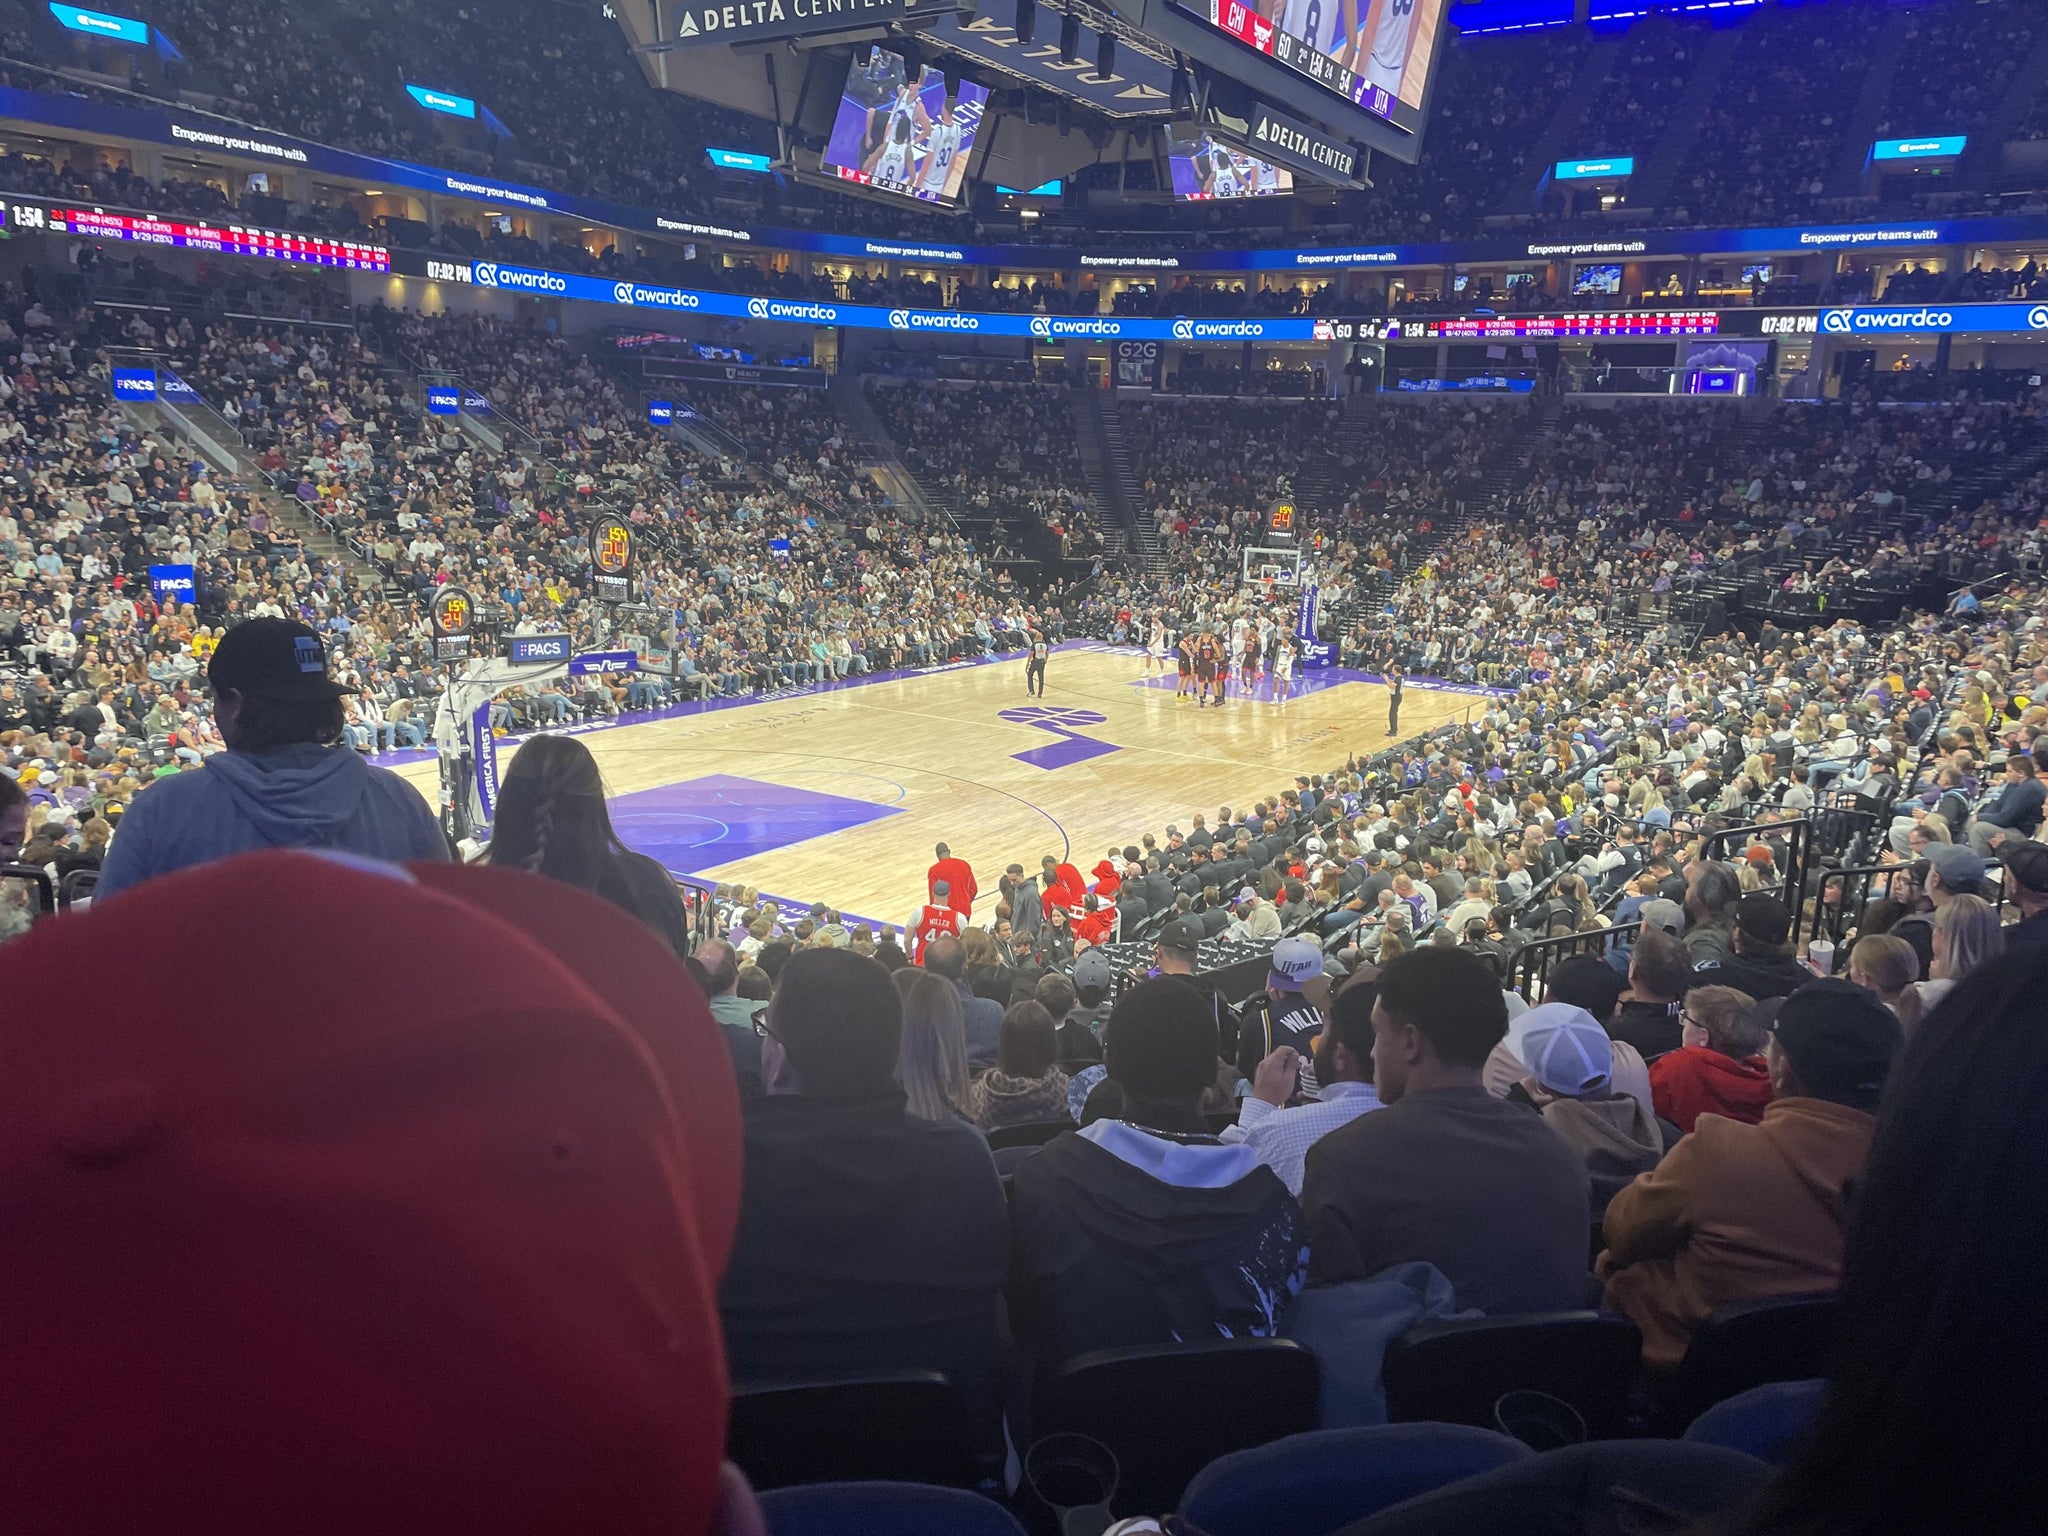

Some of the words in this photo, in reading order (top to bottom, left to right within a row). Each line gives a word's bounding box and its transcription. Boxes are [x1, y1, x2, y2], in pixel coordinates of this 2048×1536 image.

[704, 0, 785, 32] DELTA
[1228, 2, 1246, 33] CHI
[1277, 33, 1291, 60] 60
[1309, 51, 1324, 78] 1:54
[1324, 62, 1334, 80] 24
[1339, 68, 1351, 94] 54
[1374, 88, 1390, 113] UTA
[172, 125, 225, 145] Empower
[225, 136, 250, 149] your
[250, 140, 283, 156] teams
[284, 148, 307, 162] with
[1270, 122, 1309, 156] DELTA
[1312, 142, 1352, 174] CENTER
[936, 147, 952, 167] 30
[447, 177, 486, 194] Empower
[486, 188, 505, 198] your
[505, 190, 529, 203] teams
[530, 196, 547, 207] with
[12, 205, 44, 228] 1:54
[657, 217, 692, 233] Empower
[693, 223, 710, 235] your
[710, 225, 733, 237] teams
[733, 229, 750, 240] with
[1801, 232, 1851, 244] Empower
[1852, 231, 1876, 242] your
[1877, 230, 1911, 240] teams
[1912, 229, 1938, 240] with
[233, 244, 240, 252] 3
[266, 248, 276, 257] 22
[283, 250, 291, 259] 13
[300, 252, 306, 261] 4
[316, 254, 321, 263] 3
[332, 257, 337, 265] 3
[346, 259, 355, 267] 20
[361, 261, 371, 269] 104
[866, 243, 902, 255] Empower
[902, 247, 919, 257] your
[920, 247, 944, 258] teams
[945, 251, 962, 260] with
[1528, 244, 1571, 255] Empower
[1571, 243, 1592, 254] your
[1593, 242, 1622, 252] teams
[1623, 242, 1645, 251] with
[1081, 256, 1117, 267] Empower
[1118, 257, 1136, 267] your
[1136, 257, 1160, 266] teams
[1161, 257, 1178, 267] with
[1297, 254, 1333, 265] Empower
[1333, 254, 1352, 263] your
[1353, 252, 1378, 262] teams
[1378, 252, 1396, 261] with
[427, 261, 455, 280] 07:02
[456, 265, 472, 282] PM
[500, 271, 566, 291] awardco
[636, 288, 699, 308] awardco
[770, 303, 836, 320] awardco
[1856, 308, 1952, 328] awardco
[911, 313, 979, 329] awardco
[1053, 319, 1120, 334] awardco
[1196, 320, 1263, 336] awardco
[1404, 322, 1424, 337] 1:54
[1761, 316, 1794, 333] 07:02
[1797, 316, 1818, 332] PM
[1337, 324, 1352, 337] 60
[1360, 324, 1375, 337] 54
[1119, 342, 1157, 357] G2G
[124, 379, 155, 391] PACS
[436, 396, 457, 406] PACS
[654, 408, 671, 417] PACS
[1273, 513, 1290, 528] 24
[603, 541, 626, 568] 24
[160, 578, 192, 590] PACS
[604, 576, 628, 586] TISSOT
[444, 612, 462, 628] 24
[447, 635, 470, 643] TISSOT
[528, 641, 561, 657] PACS
[481, 726, 491, 760] FIRST
[483, 761, 496, 811] AMERICA
[929, 918, 950, 928] MILLER
[1280, 1007, 1324, 1033] WILLI
